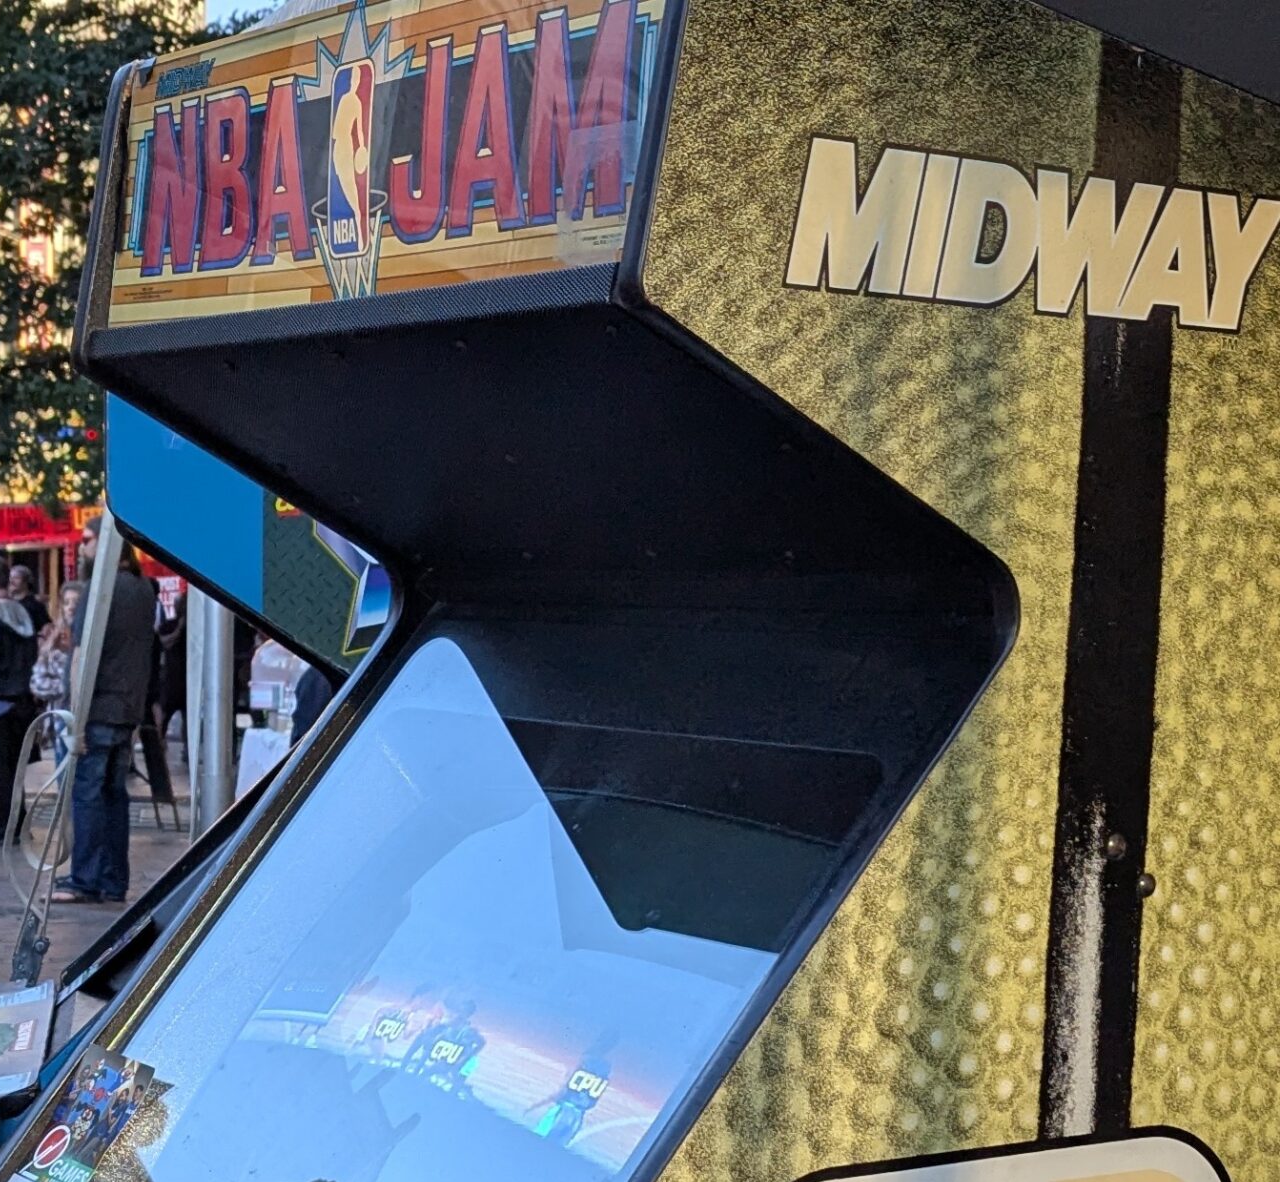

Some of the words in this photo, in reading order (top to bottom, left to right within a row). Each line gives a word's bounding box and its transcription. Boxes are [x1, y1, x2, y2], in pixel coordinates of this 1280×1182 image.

[141, 74, 316, 277] NBA
[390, 0, 637, 245] JAM
[333, 217, 357, 245] NBA
[784, 134, 1280, 334] MIDWAY
[375, 1018, 405, 1041] CPU
[430, 1040, 464, 1064] CPU
[568, 1070, 609, 1098] CPU
